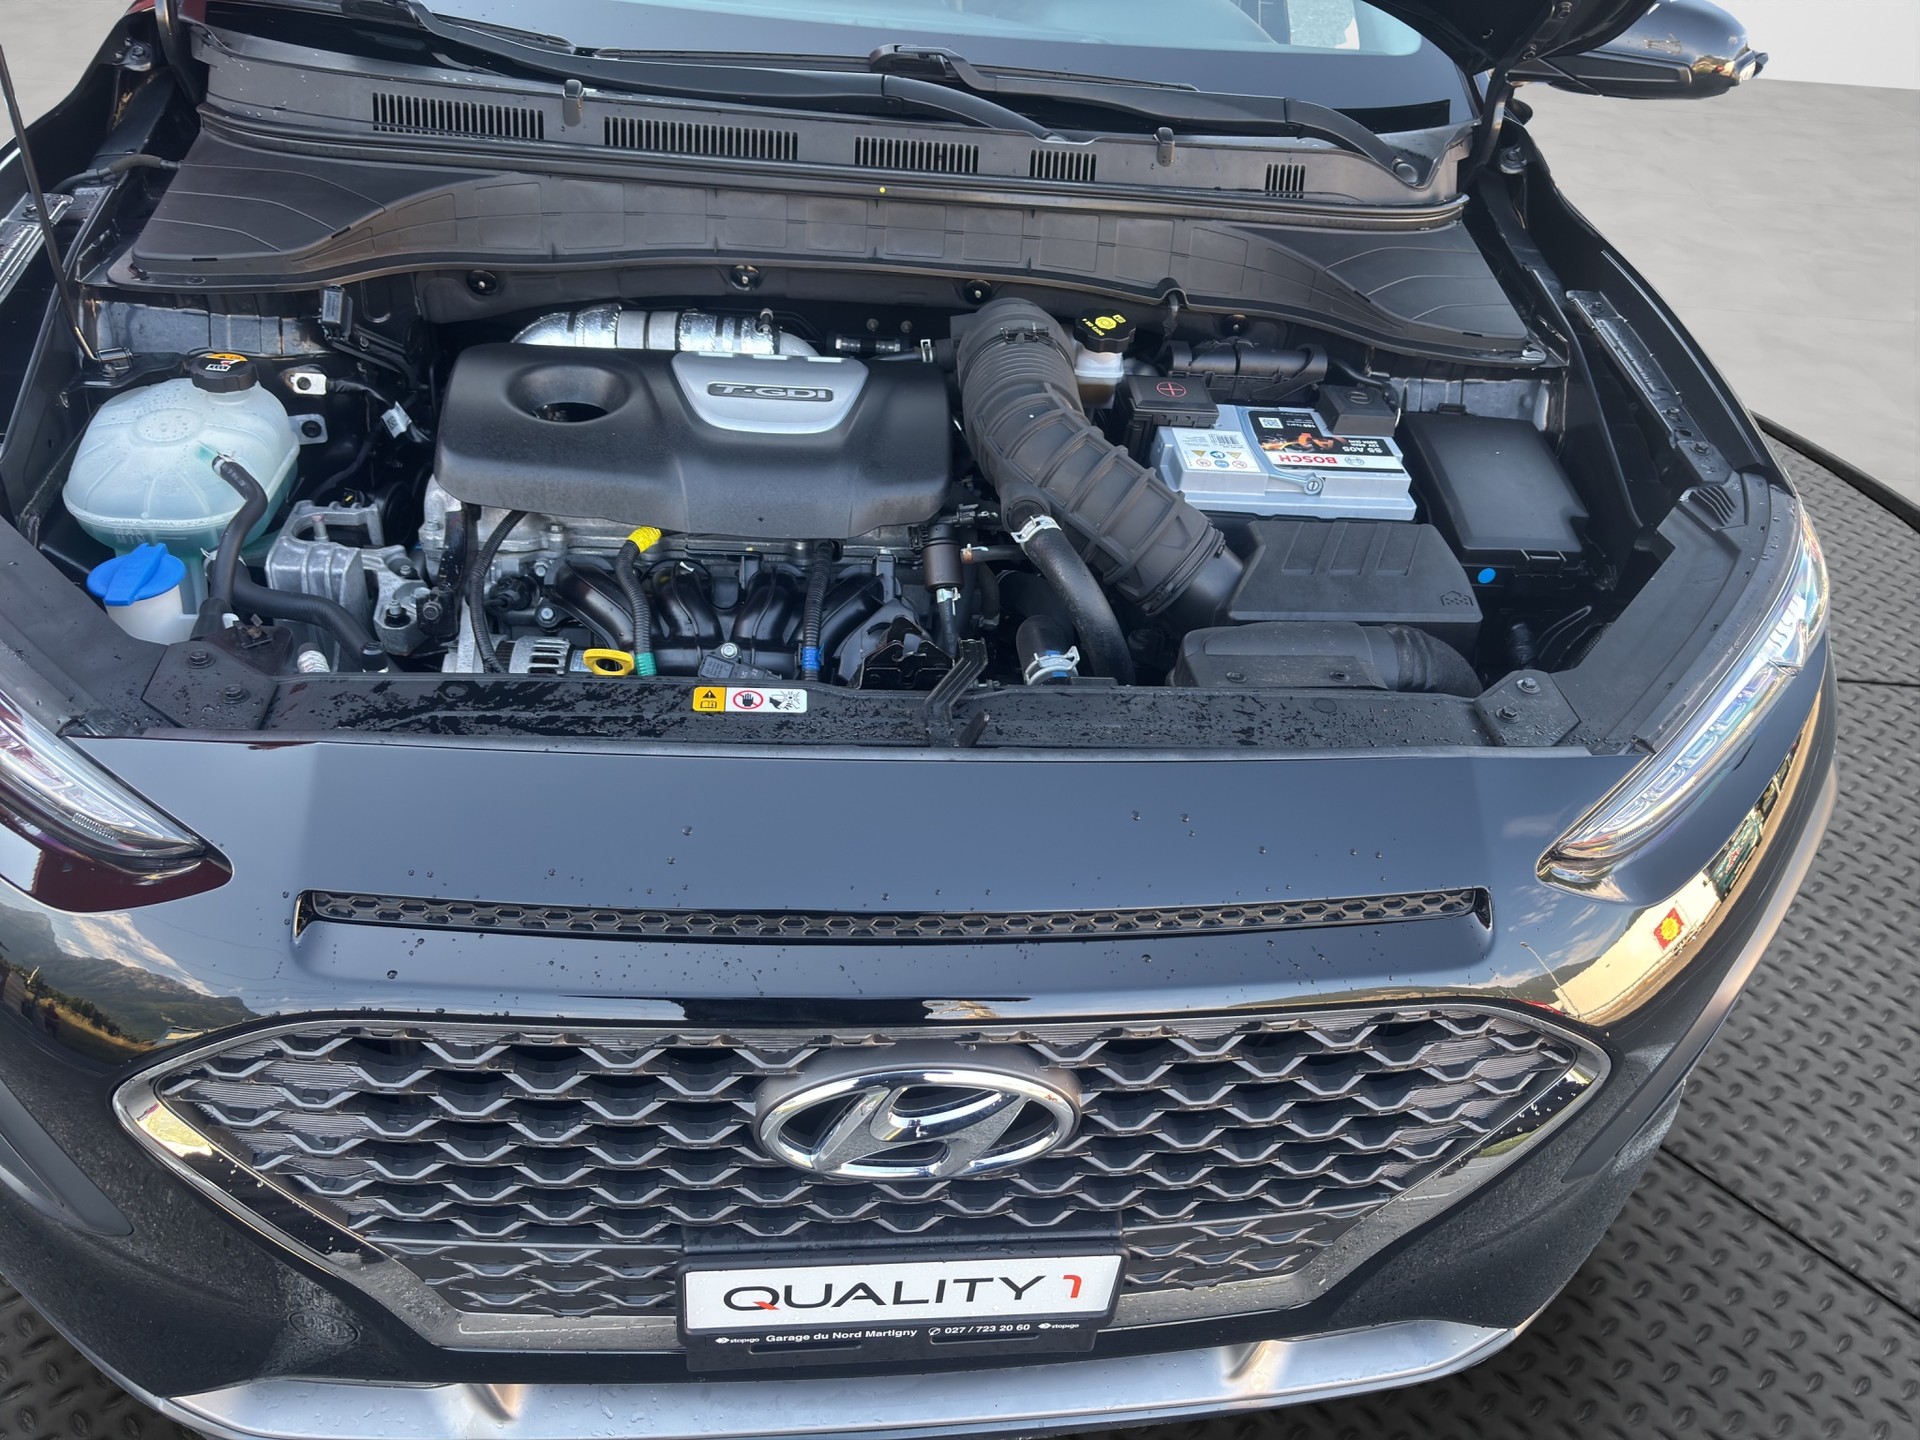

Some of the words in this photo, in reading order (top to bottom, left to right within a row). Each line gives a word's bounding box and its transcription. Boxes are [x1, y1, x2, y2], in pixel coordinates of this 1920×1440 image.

[1278, 454, 1338, 465] BOSCH
[722, 1275, 1047, 1311] QUALITY
[765, 1334, 811, 1343] Garage
[812, 1332, 829, 1340] du
[832, 1330, 862, 1339] Nord
[865, 1329, 918, 1339] Martigny
[944, 1326, 967, 1335] 027
[975, 1325, 997, 1333] 723
[998, 1324, 1014, 1332] 20
[1015, 1323, 1031, 1331] 60
